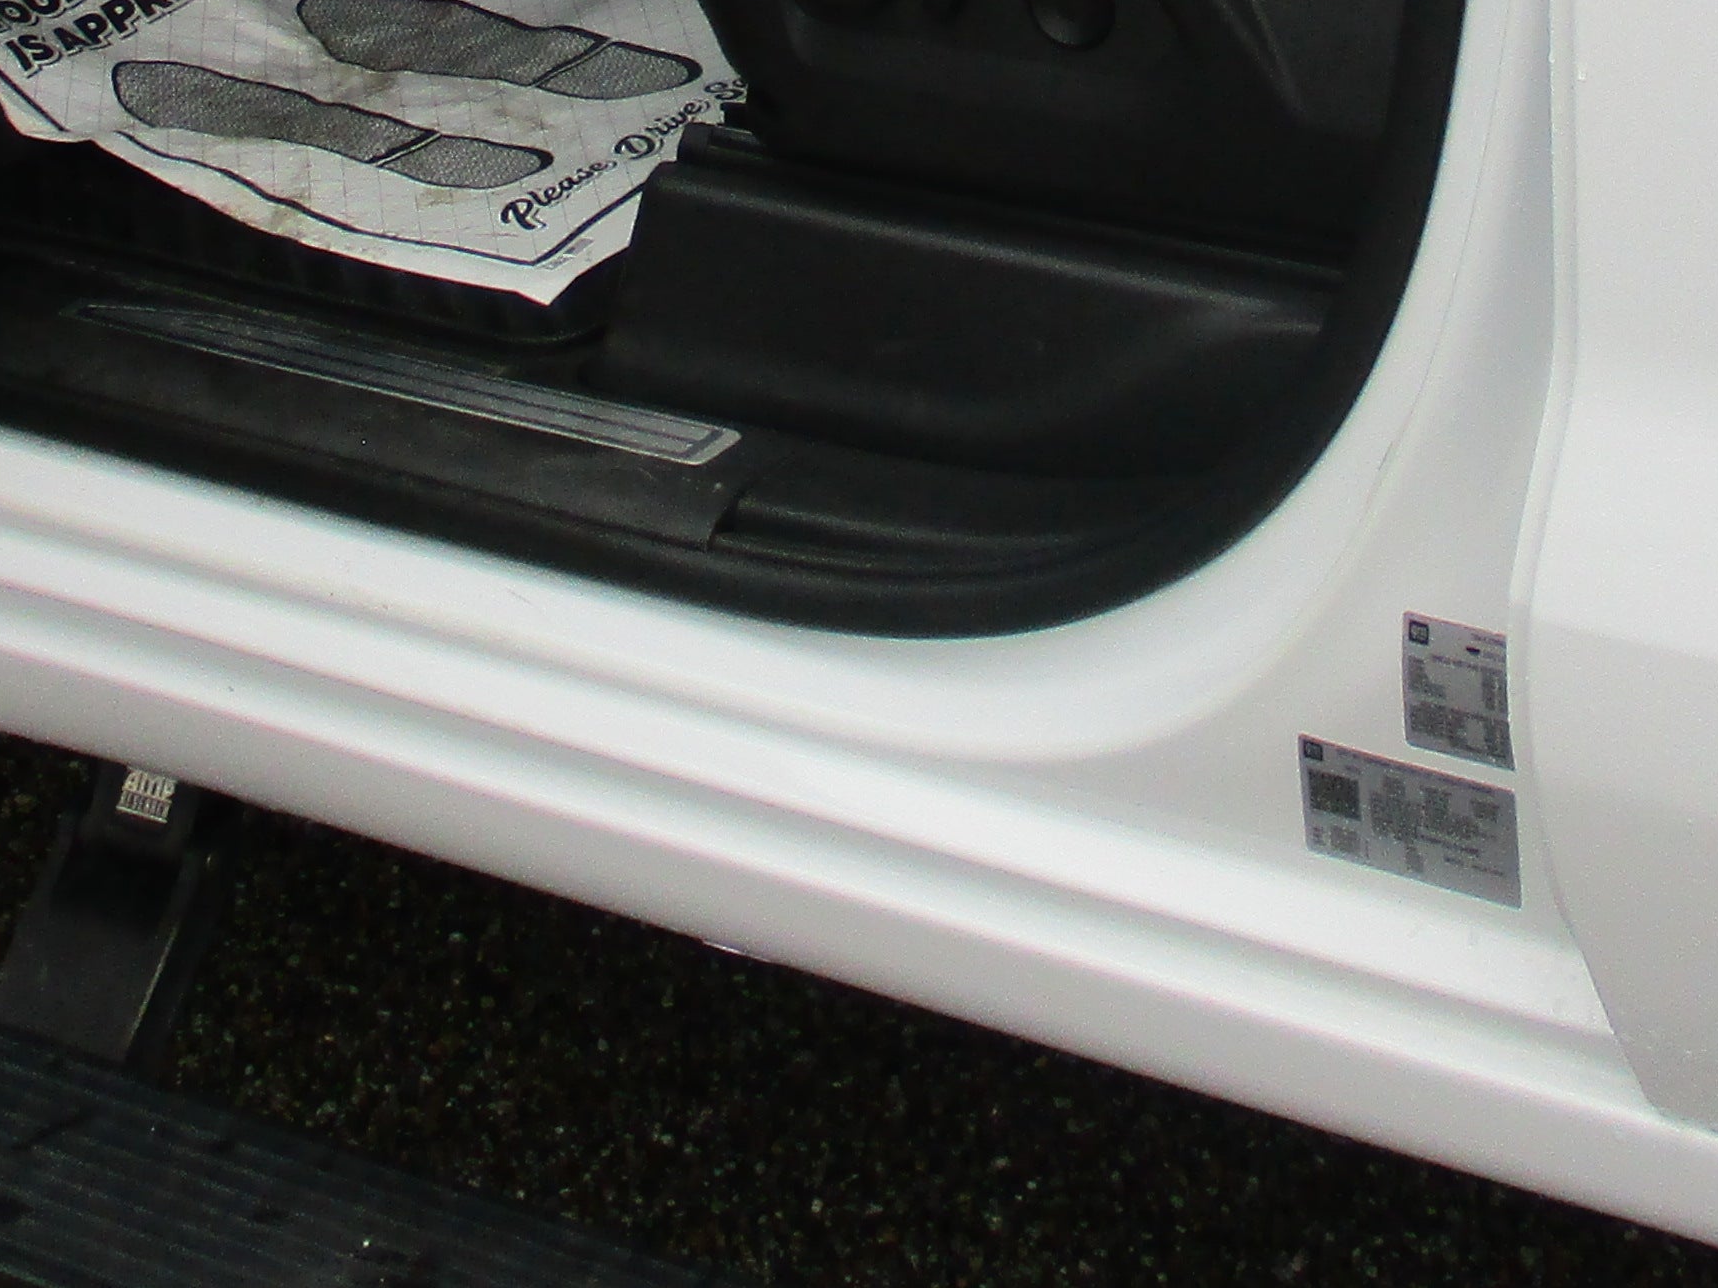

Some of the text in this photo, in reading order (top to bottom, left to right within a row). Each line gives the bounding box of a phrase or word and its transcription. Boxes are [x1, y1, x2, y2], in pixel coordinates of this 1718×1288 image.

[4, 33, 60, 75] IS
[500, 160, 614, 230] Please
[614, 100, 709, 160] Drive
